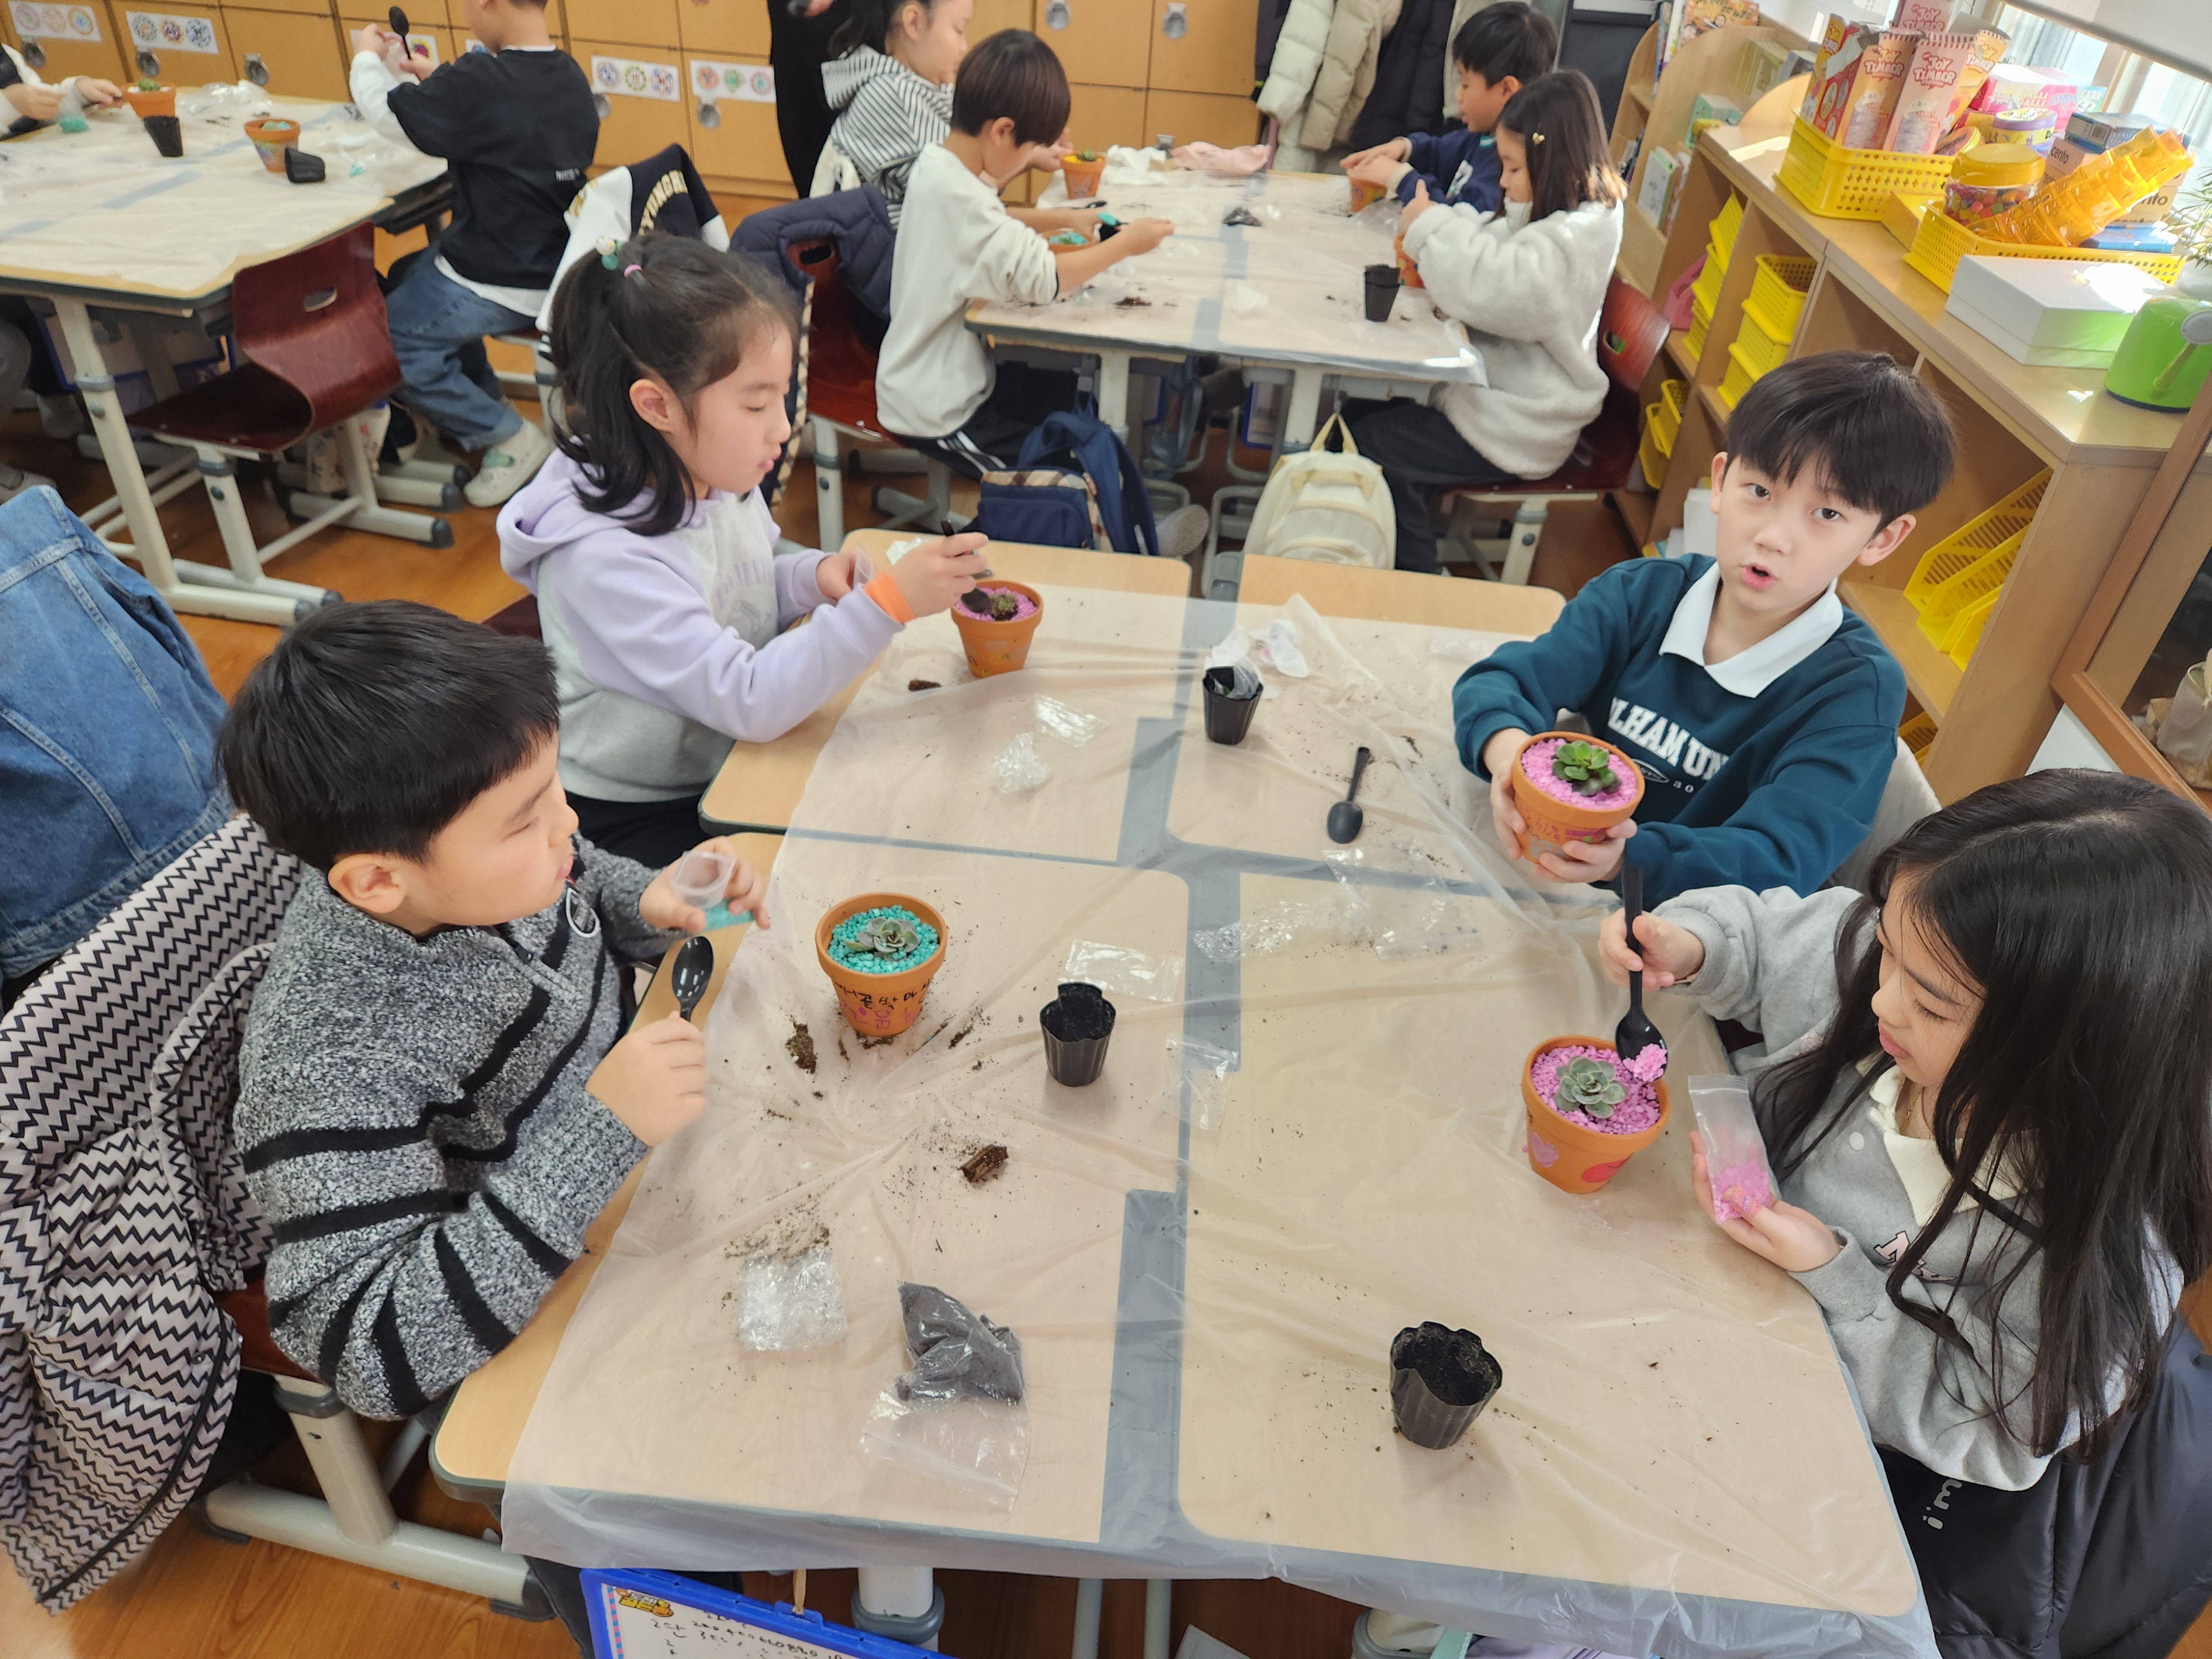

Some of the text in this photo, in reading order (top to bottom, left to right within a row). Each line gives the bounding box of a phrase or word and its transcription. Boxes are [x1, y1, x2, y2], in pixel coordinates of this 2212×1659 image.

[1916, 8, 1941, 21] JOY
[1878, 48, 1902, 63] JOY
[1864, 61, 1905, 77] TIMBER
[1928, 56, 1953, 71] JOY
[1913, 68, 1957, 85] TIMBER
[2051, 146, 2069, 165] cento
[2141, 190, 2168, 205] nto
[1608, 696, 1690, 768] LHAM
